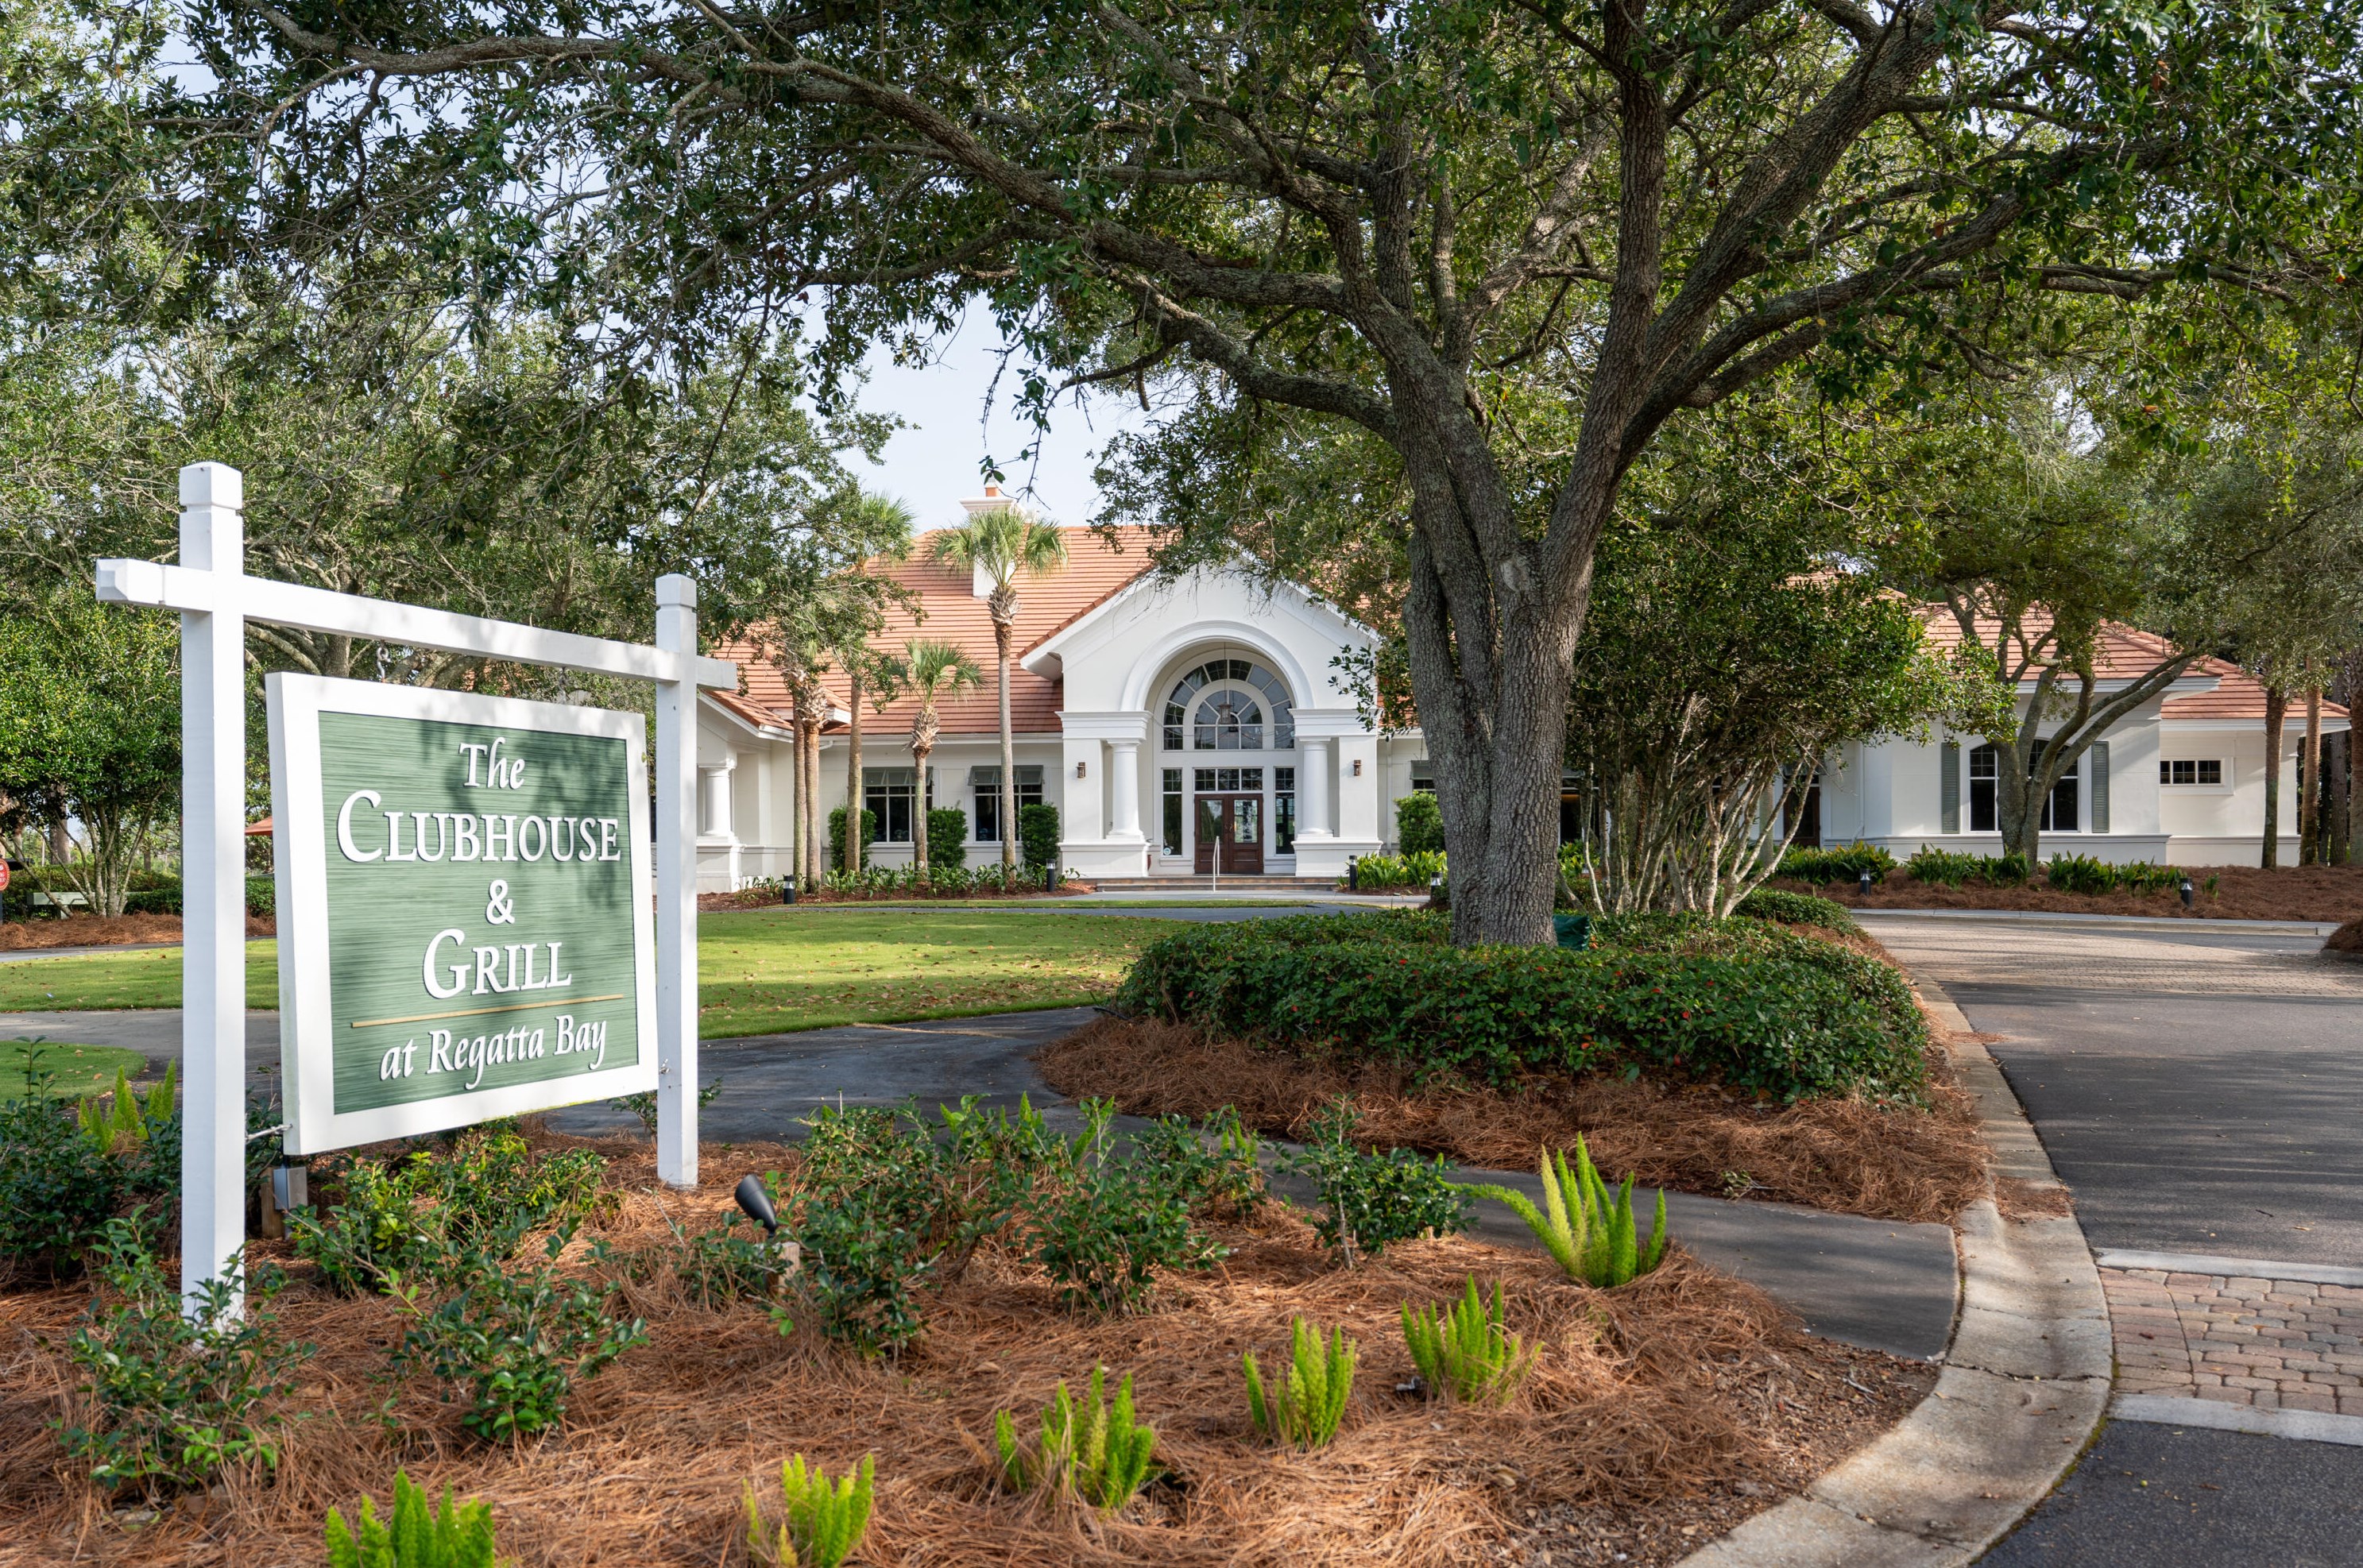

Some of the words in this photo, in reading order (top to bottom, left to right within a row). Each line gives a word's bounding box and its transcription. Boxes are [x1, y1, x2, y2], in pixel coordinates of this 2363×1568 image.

[459, 736, 525, 790] The
[337, 790, 621, 863] CLUBHOUSE
[485, 879, 516, 925] &
[423, 929, 572, 998] GRILL
[380, 1038, 418, 1081] at
[426, 1025, 544, 1090] Regatta
[554, 1014, 607, 1070] Bay
